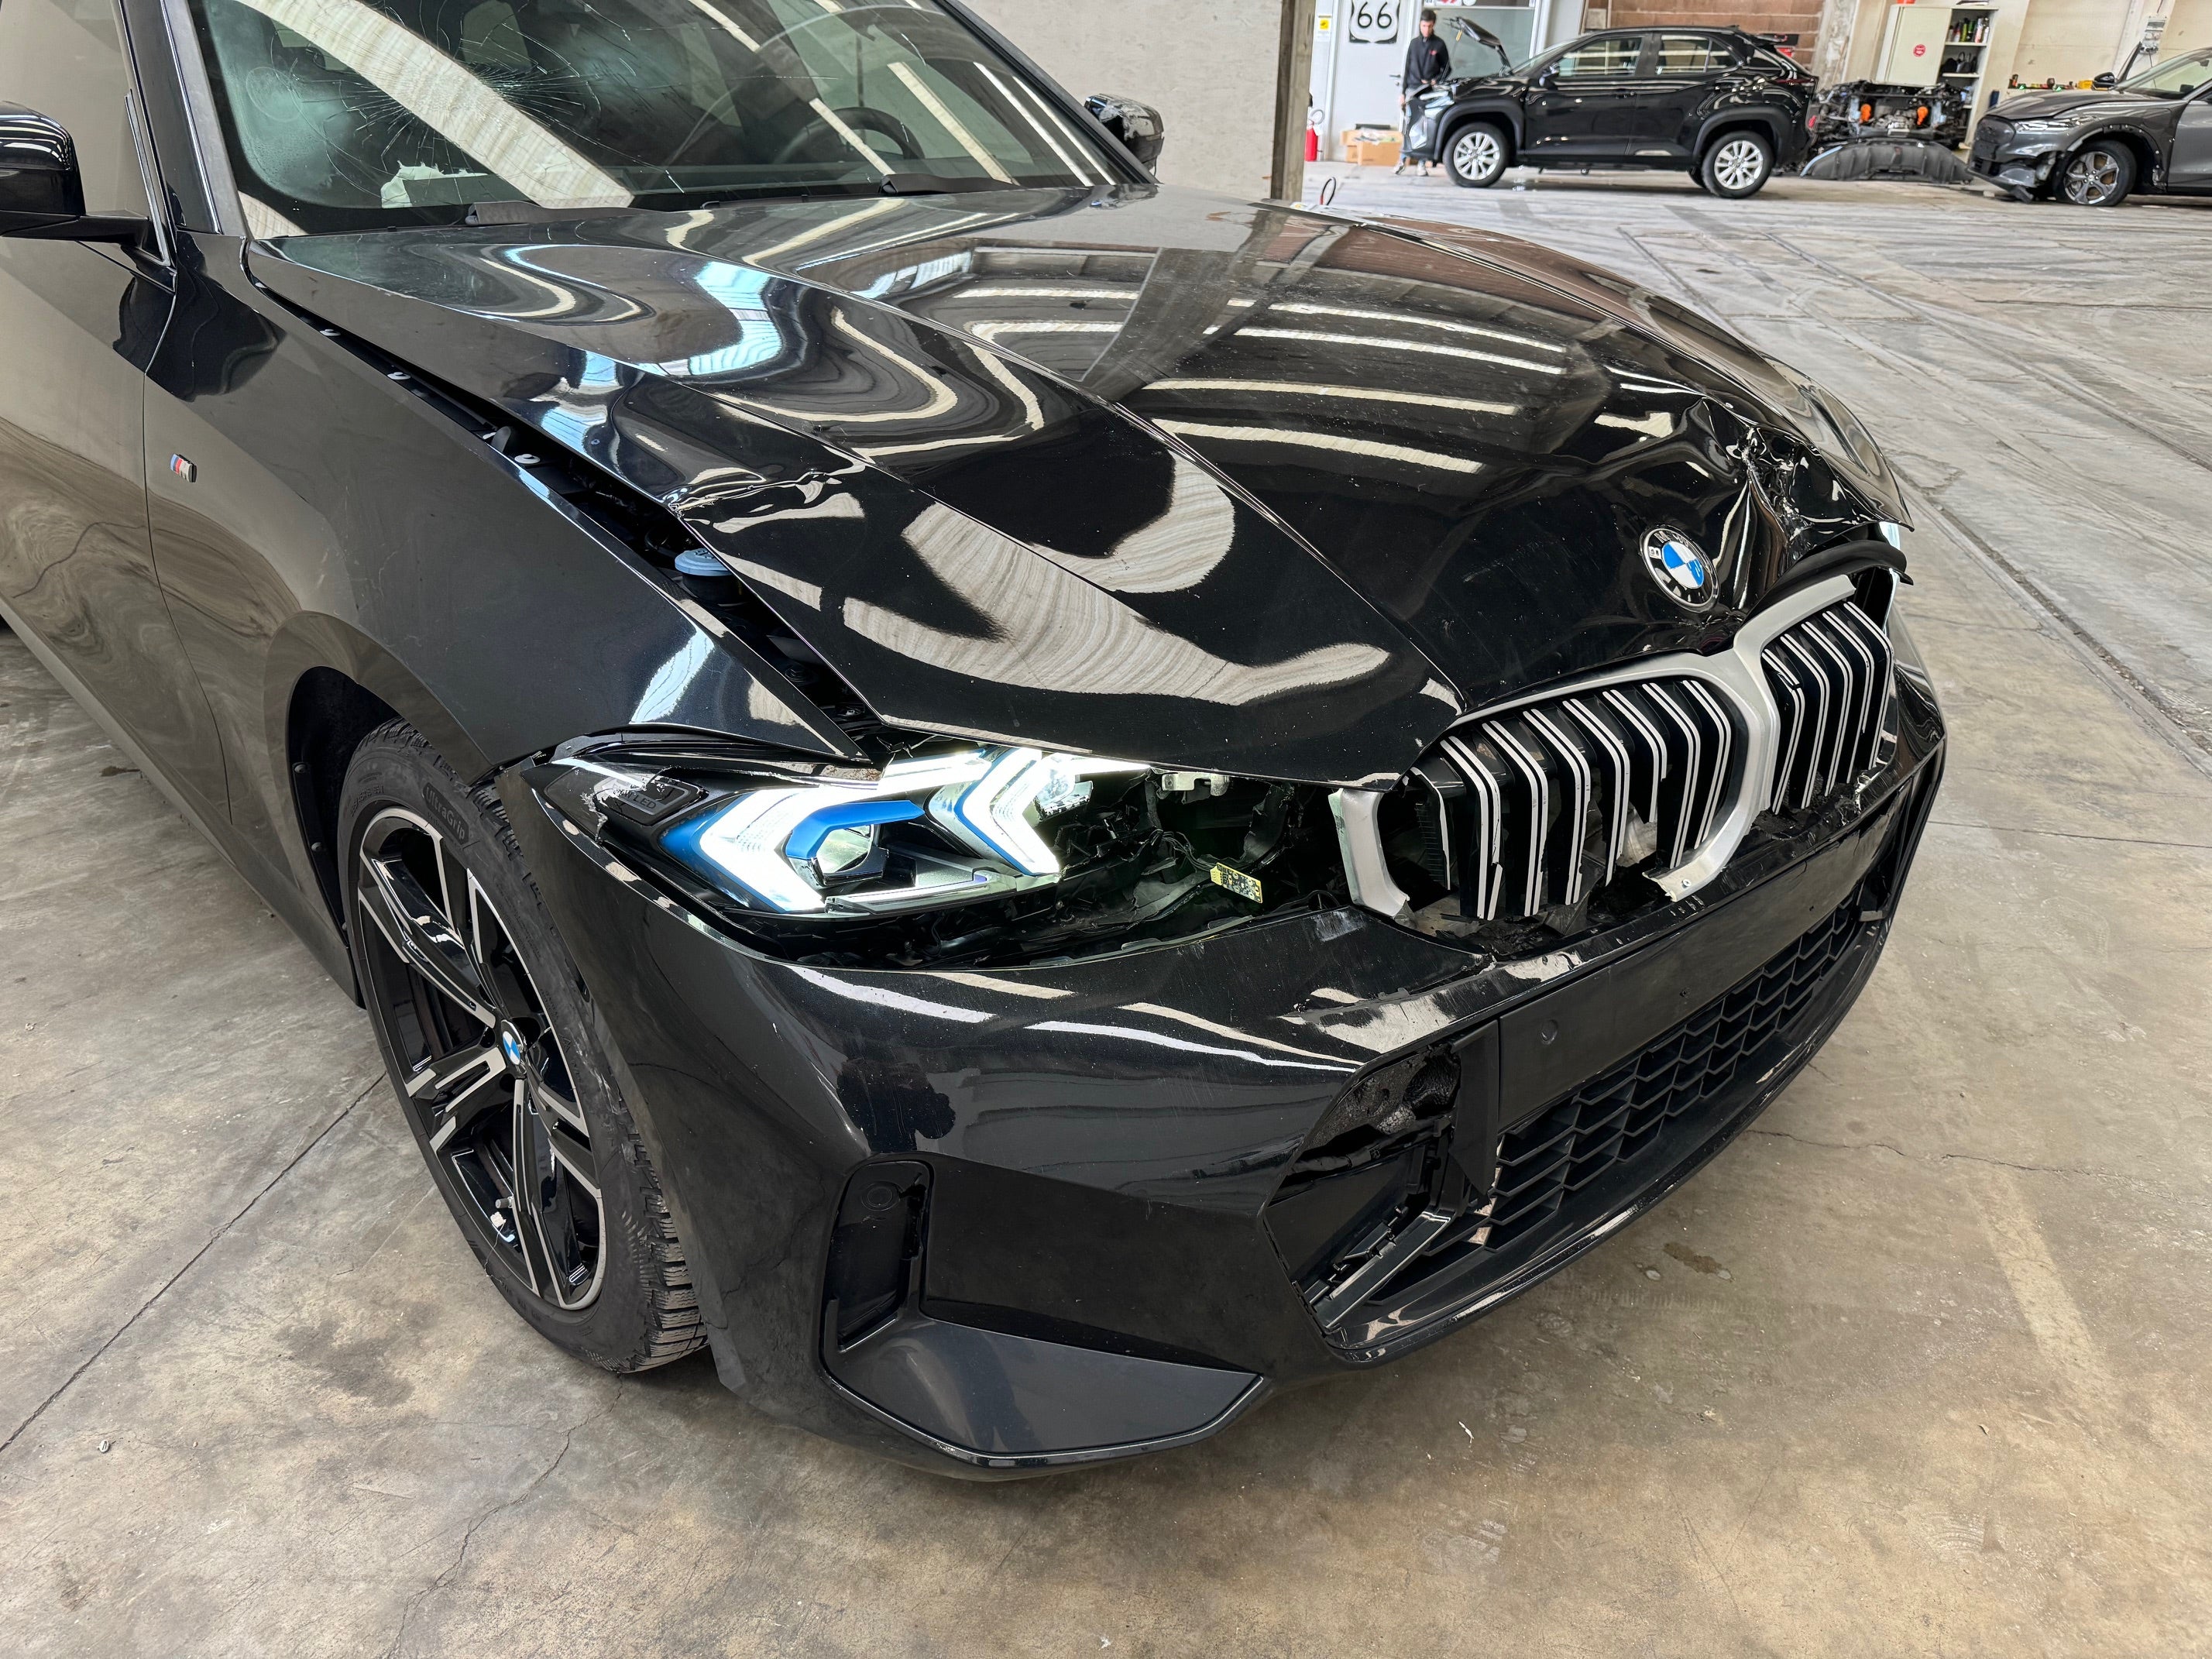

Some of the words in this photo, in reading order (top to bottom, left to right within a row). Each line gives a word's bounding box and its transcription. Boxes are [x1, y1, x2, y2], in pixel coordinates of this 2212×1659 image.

[1358, 2, 1393, 29] 66
[1648, 531, 1689, 559] BMW
[426, 786, 465, 840] UltraGrip
[633, 794, 657, 809] LED
